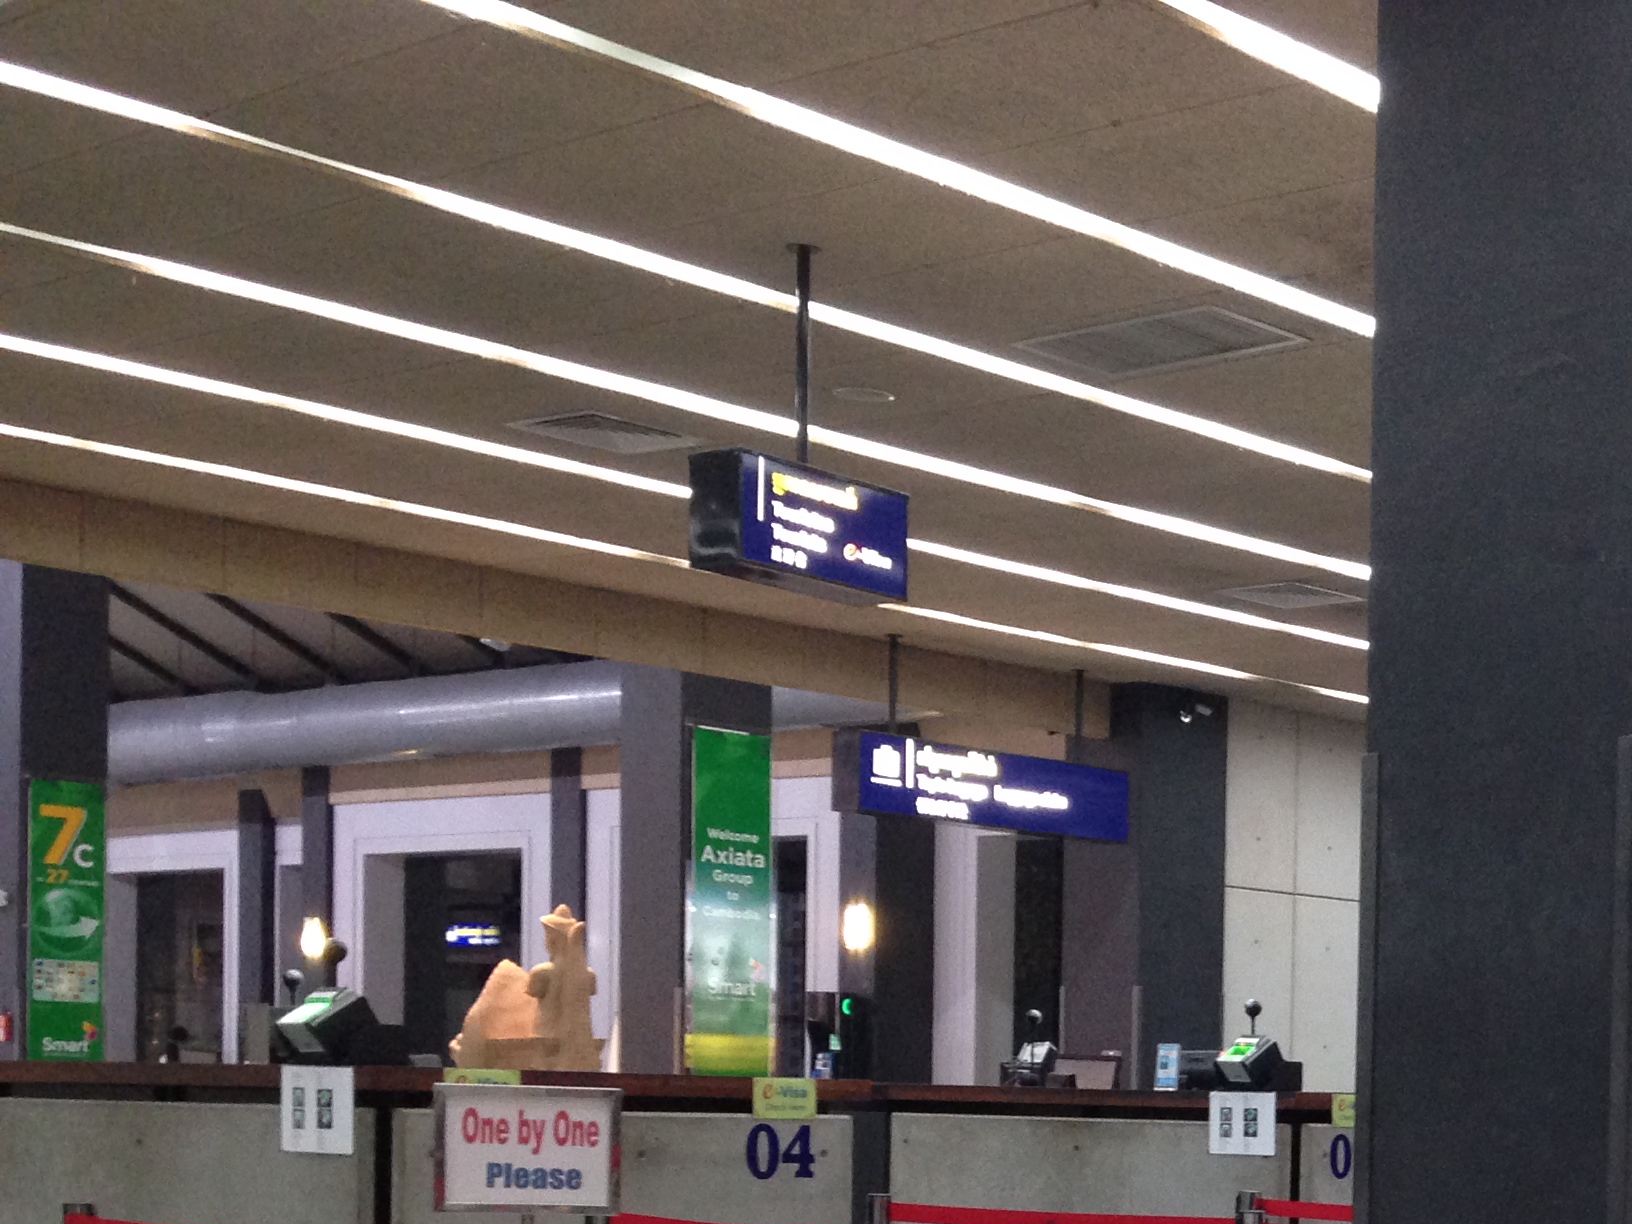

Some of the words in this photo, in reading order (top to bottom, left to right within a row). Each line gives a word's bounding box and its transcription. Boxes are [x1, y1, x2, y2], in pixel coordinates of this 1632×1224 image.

[706, 827, 760, 844] Welcome
[701, 845, 766, 868] Axiata
[712, 869, 754, 886] Group
[42, 1036, 89, 1052] Smart
[462, 1107, 510, 1145] One
[518, 1108, 546, 1155] by
[553, 1110, 600, 1147] One
[746, 1123, 815, 1179] 04
[486, 1162, 582, 1190] Please
